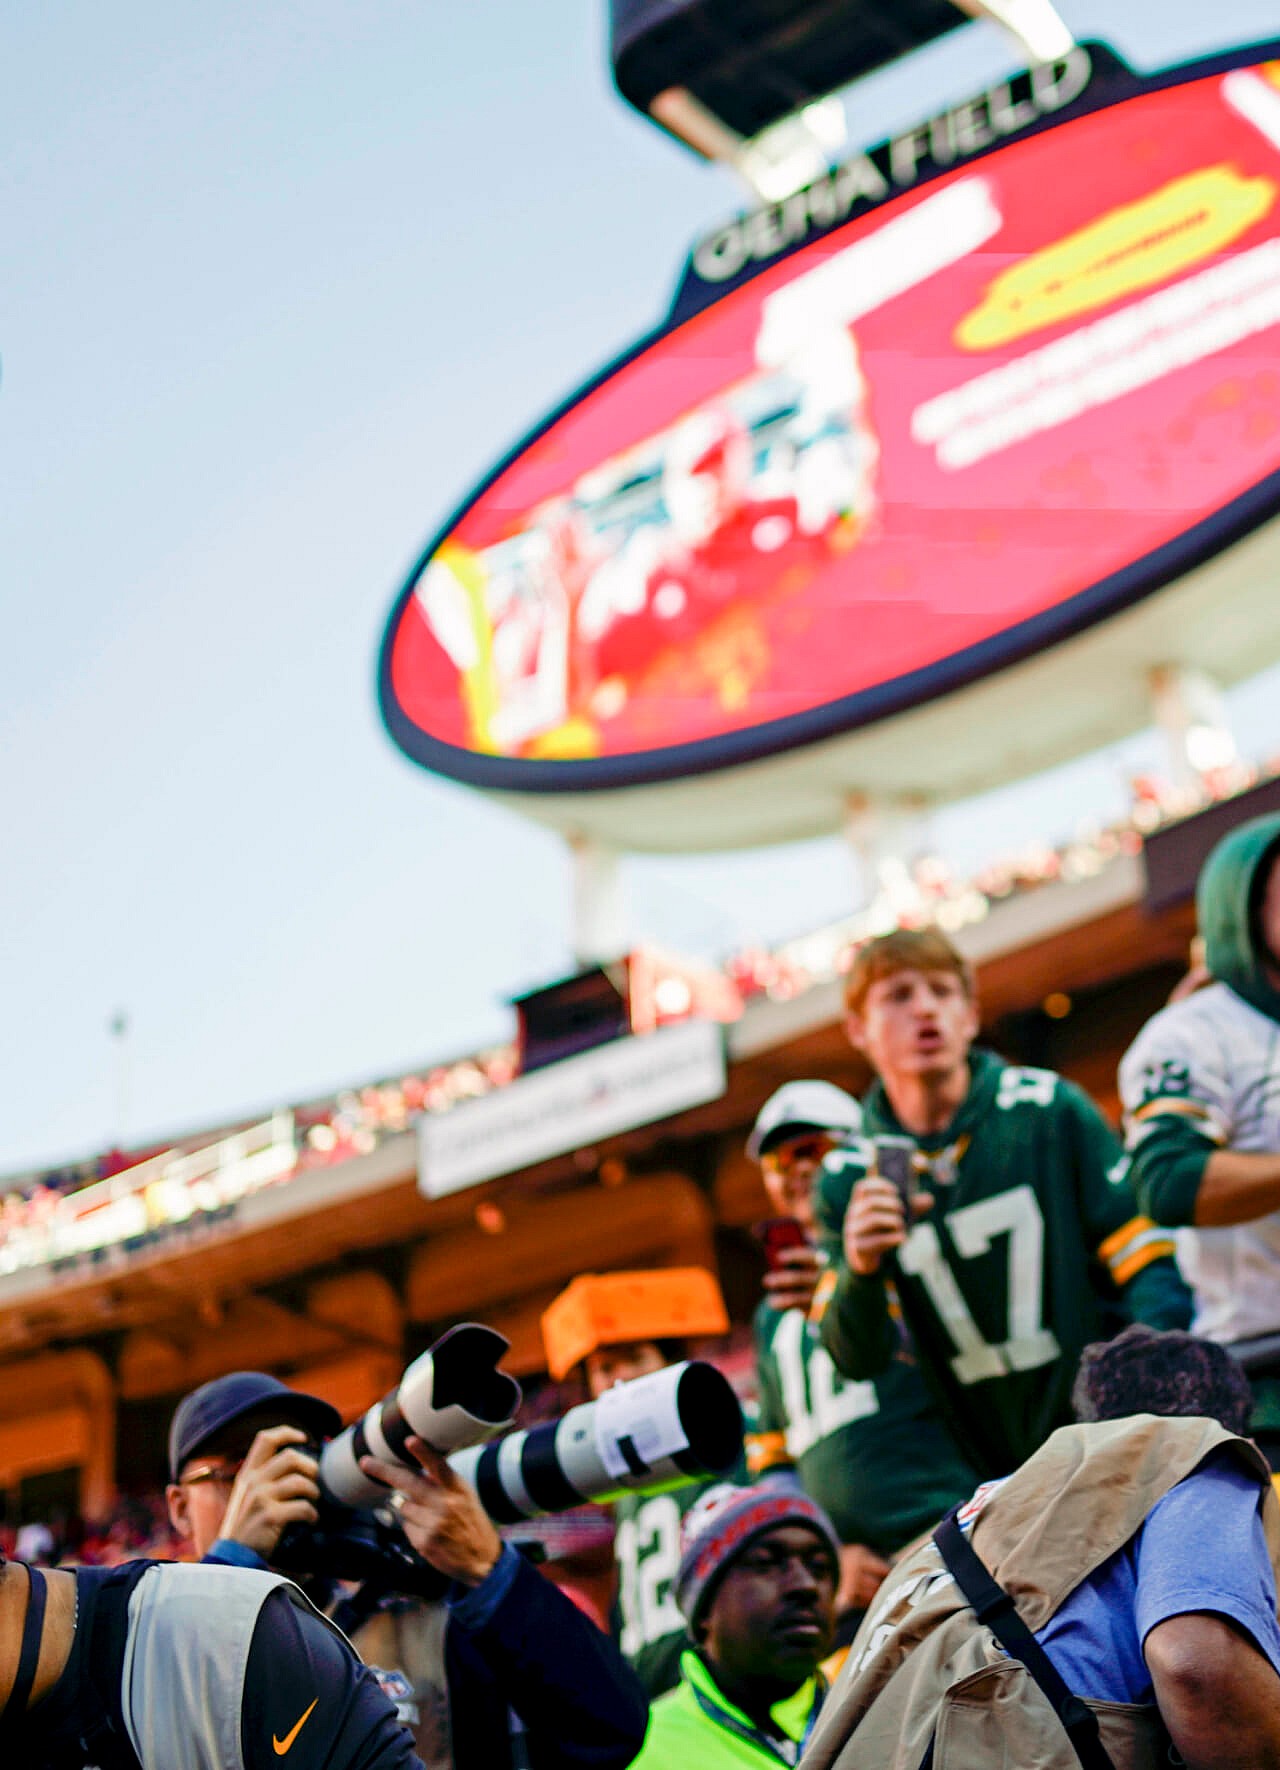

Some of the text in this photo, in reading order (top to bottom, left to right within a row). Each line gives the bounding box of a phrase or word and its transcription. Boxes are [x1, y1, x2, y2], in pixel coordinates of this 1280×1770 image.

[888, 46, 1092, 184] FIELD
[899, 1184, 1062, 1386] 17
[614, 1496, 688, 1657] 12
